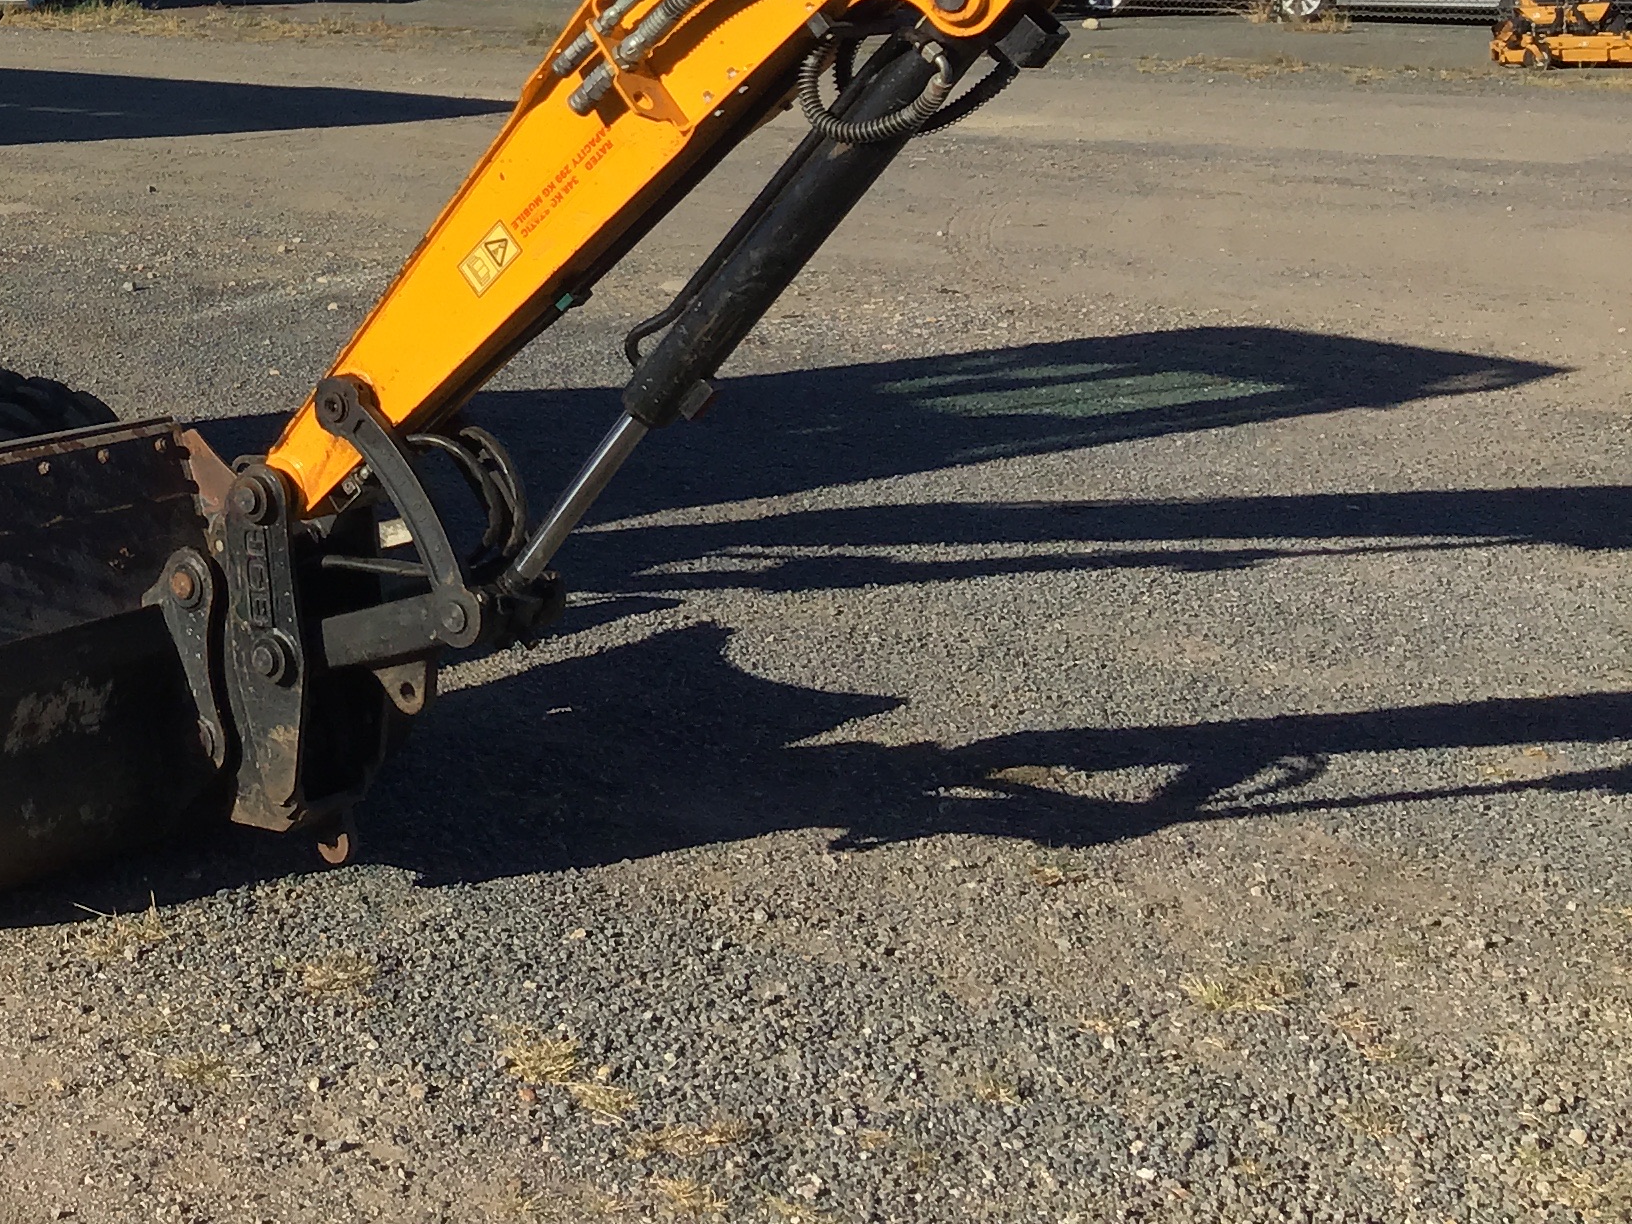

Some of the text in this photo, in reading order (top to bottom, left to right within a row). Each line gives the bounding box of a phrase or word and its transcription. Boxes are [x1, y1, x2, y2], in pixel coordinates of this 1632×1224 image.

[584, 139, 615, 172] RATED
[541, 182, 558, 198] KG
[554, 164, 574, 184] 299
[510, 196, 544, 231] MOBILE
[246, 530, 271, 627] JCB
